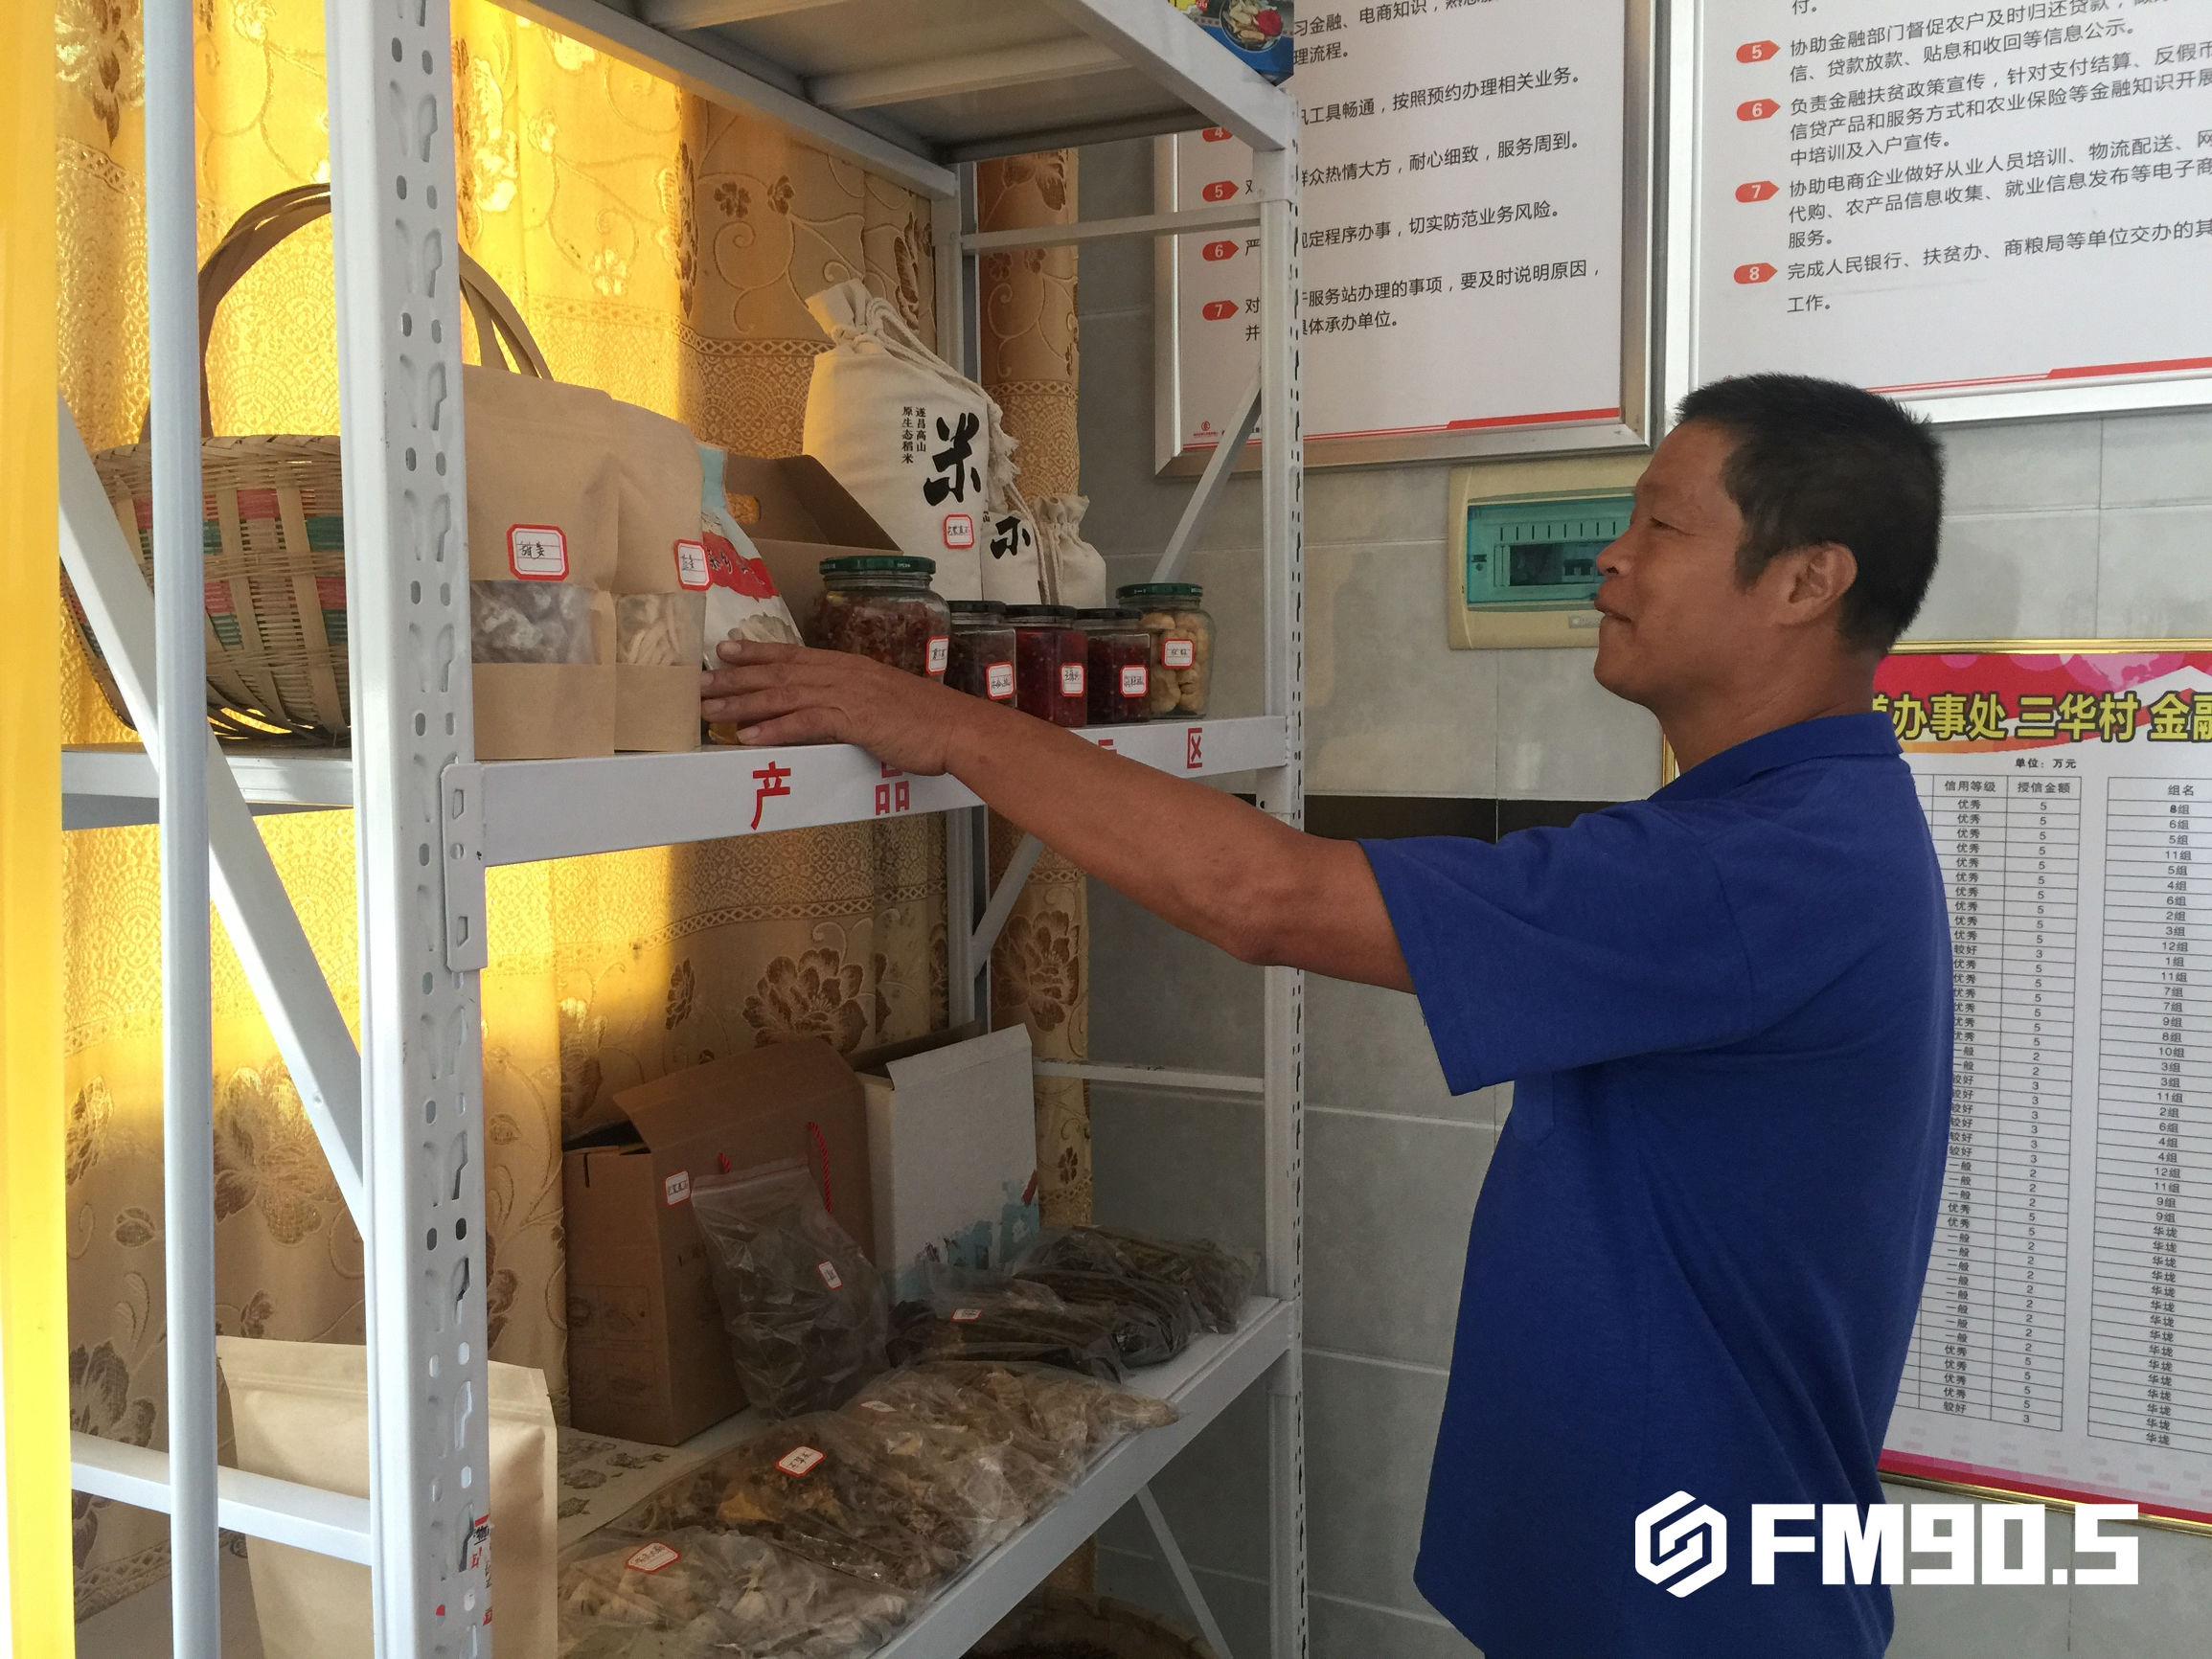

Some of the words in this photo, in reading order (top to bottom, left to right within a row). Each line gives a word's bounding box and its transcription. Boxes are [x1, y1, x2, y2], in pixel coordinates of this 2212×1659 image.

[1293, 0, 1500, 36] 习金融、电商知识，
[1751, 44, 1763, 59] 5
[1790, 0, 2169, 57] 协助金融部门督促农户及时归还贷款，
[1293, 41, 1349, 66] 理流程。
[1790, 17, 2134, 83] 信、贷款放款、贴息和收回等信息公示。
[1751, 102, 1763, 118] 6
[1790, 130, 1950, 168] 中培训及入户宣传。
[1214, 184, 1224, 198] 5
[1752, 184, 1763, 199] 7
[1788, 228, 1834, 250] 服务。
[1214, 244, 1224, 259] 6
[1748, 266, 1761, 282] 8
[1787, 293, 1833, 314] 工作。
[1214, 304, 1223, 318] 7
[901, 405, 914, 465] 原生态稻米
[915, 406, 926, 453] 遂昌高山
[923, 412, 982, 507] 米
[1872, 692, 2007, 741] 办事处
[2015, 691, 2141, 743] 三华村
[1944, 780, 1996, 793] 信用等级
[2017, 781, 2071, 794] 授信金额
[2167, 784, 2195, 797] 组名
[1958, 800, 1981, 809] 优秀
[2040, 801, 2047, 811] 5
[2169, 805, 2189, 814] 8组
[1957, 814, 1980, 824] 优秀
[2040, 816, 2047, 826] 5
[2169, 820, 2189, 830] 6组
[1957, 829, 1980, 838] 优秀
[2039, 830, 2047, 841] 5
[2168, 835, 2188, 845] 5组
[1956, 843, 1979, 853] 优秀
[2039, 846, 2046, 856] 5
[2165, 851, 2192, 860] 11组
[1956, 857, 1979, 868] 优秀
[2038, 860, 2046, 871] 5
[2167, 866, 2187, 875] 5组
[1956, 872, 1978, 882] 优秀
[2038, 875, 2045, 885] 5
[2166, 881, 2186, 891] 4组
[1955, 887, 1978, 897] 优秀
[2037, 890, 2045, 900] 5
[2166, 897, 2186, 906] 6组
[1955, 901, 1977, 911] 优秀
[2037, 904, 2045, 915] 5
[2165, 911, 2185, 921] 2组
[1954, 916, 1977, 926] 优秀
[2036, 920, 2044, 929] 5
[1954, 930, 1977, 941] 优秀
[2036, 934, 2043, 944] 5
[2165, 926, 2185, 936] 3组
[1954, 943, 1977, 956] 较好
[2035, 948, 2043, 959] 3
[2162, 942, 2188, 952] 12组
[1954, 959, 1977, 970] 优秀
[2035, 964, 2042, 973] 5
[2165, 957, 2184, 966] 1组
[1954, 973, 1976, 985] 优秀
[2035, 978, 2042, 989] 5
[2161, 972, 2187, 982] 11组
[2034, 993, 2042, 1003] 5
[2164, 987, 2183, 997] 7组
[2163, 1002, 2182, 1011] 7组
[2034, 1008, 2041, 1018] 5
[2034, 1022, 2041, 1033] 5
[2162, 1016, 2182, 1027] 9组
[2033, 1037, 2041, 1047] 5
[2161, 1033, 2182, 1042] 8组
[2032, 1052, 2041, 1061] 2
[2158, 1047, 2184, 1057] 10组
[2032, 1066, 2040, 1077] 2
[2160, 1062, 2180, 1073] 3组
[2032, 1080, 2040, 1091] 3
[2160, 1078, 2180, 1087] 3组
[2031, 1095, 2040, 1105] 3
[2156, 1093, 2182, 1102] 11组
[2031, 1110, 2039, 1121] 3
[2158, 1107, 2179, 1118] 2组
[2030, 1125, 2039, 1134] 3
[2158, 1123, 2178, 1133] 6组
[1950, 1131, 1973, 1143] 较好
[2030, 1139, 2039, 1149] 3
[2157, 1138, 2178, 1148] 4组
[1949, 1146, 1973, 1157] 较好
[2030, 1154, 2038, 1164] 3
[2157, 1152, 2177, 1163] 4组
[1949, 1161, 1972, 1171] 一般
[2029, 1169, 2038, 1179] 2
[2155, 1168, 2180, 1178] 12组
[1949, 1175, 1971, 1186] 一般
[2029, 1183, 2037, 1193] 2
[2154, 1182, 2179, 1193] 11组
[1949, 1190, 1971, 1199] 一般
[2028, 1197, 2037, 1208] 2
[2155, 1197, 2177, 1208] 9组
[1948, 1203, 1970, 1214] 优秀
[2028, 1212, 2036, 1222] 5
[2155, 1212, 2175, 1222] 9组
[1948, 1217, 1970, 1228] 优秀
[2028, 1226, 2036, 1237] 5
[1948, 1233, 1970, 1242] 一般
[2027, 1240, 2036, 1251] 2
[1948, 1247, 1970, 1257] 一般
[2027, 1256, 2035, 1265] 2
[1948, 1261, 1969, 1271] 一般
[2026, 1270, 2035, 1281] 2
[1947, 1275, 1969, 1286] 一般
[2026, 1284, 2034, 1295] 2
[1947, 1290, 1968, 1300] 一般
[2025, 1299, 2034, 1308] 2
[1947, 1305, 1968, 1314] 一般
[2025, 1313, 2034, 1324] 2
[1947, 1319, 1968, 1329] 一般
[2025, 1328, 2033, 1338] 2
[1946, 1332, 1968, 1343] 一般
[2024, 1342, 2033, 1352] 2
[2024, 1356, 2032, 1366] 5
[2023, 1371, 2032, 1381] 5
[2023, 1385, 2032, 1395] 5
[2023, 1399, 2031, 1409] 5
[2022, 1414, 2030, 1423] 3
